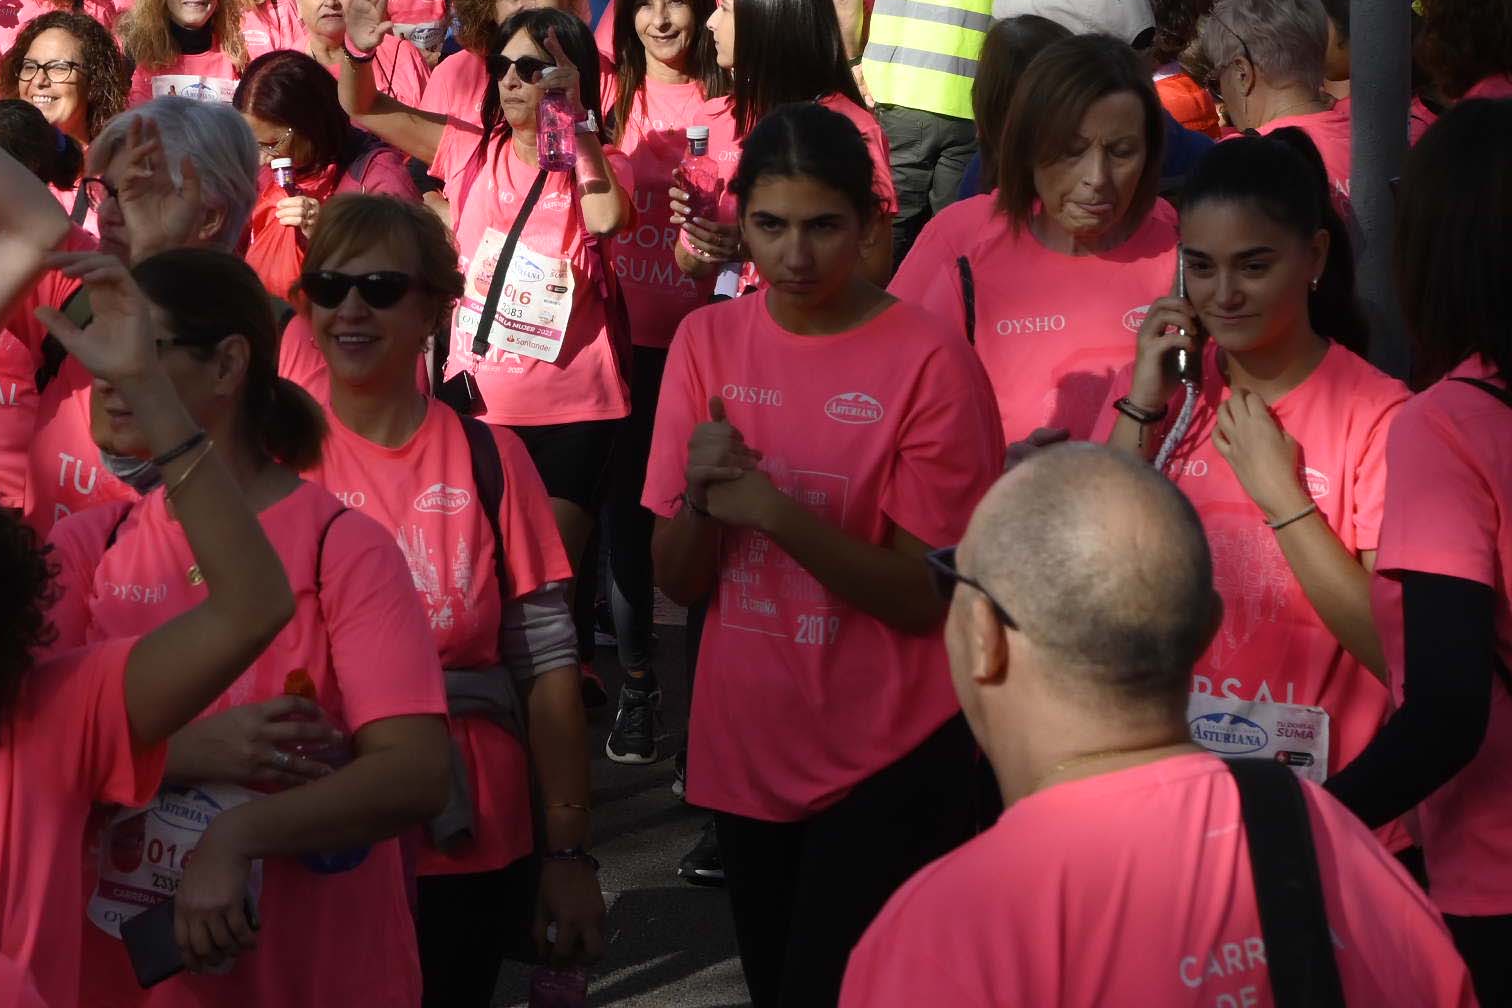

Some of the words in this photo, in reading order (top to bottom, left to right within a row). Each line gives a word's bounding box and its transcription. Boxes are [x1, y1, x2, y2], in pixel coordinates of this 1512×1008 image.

[615, 255, 696, 289] SUMA
[996, 314, 1066, 336] OYSHO
[516, 337, 551, 353] Santander
[721, 383, 785, 408] OYSHO
[58, 451, 97, 495] TU
[795, 614, 840, 646] 2019
[1193, 723, 1262, 746] ASTURIANA
[1275, 727, 1316, 740] SUMA
